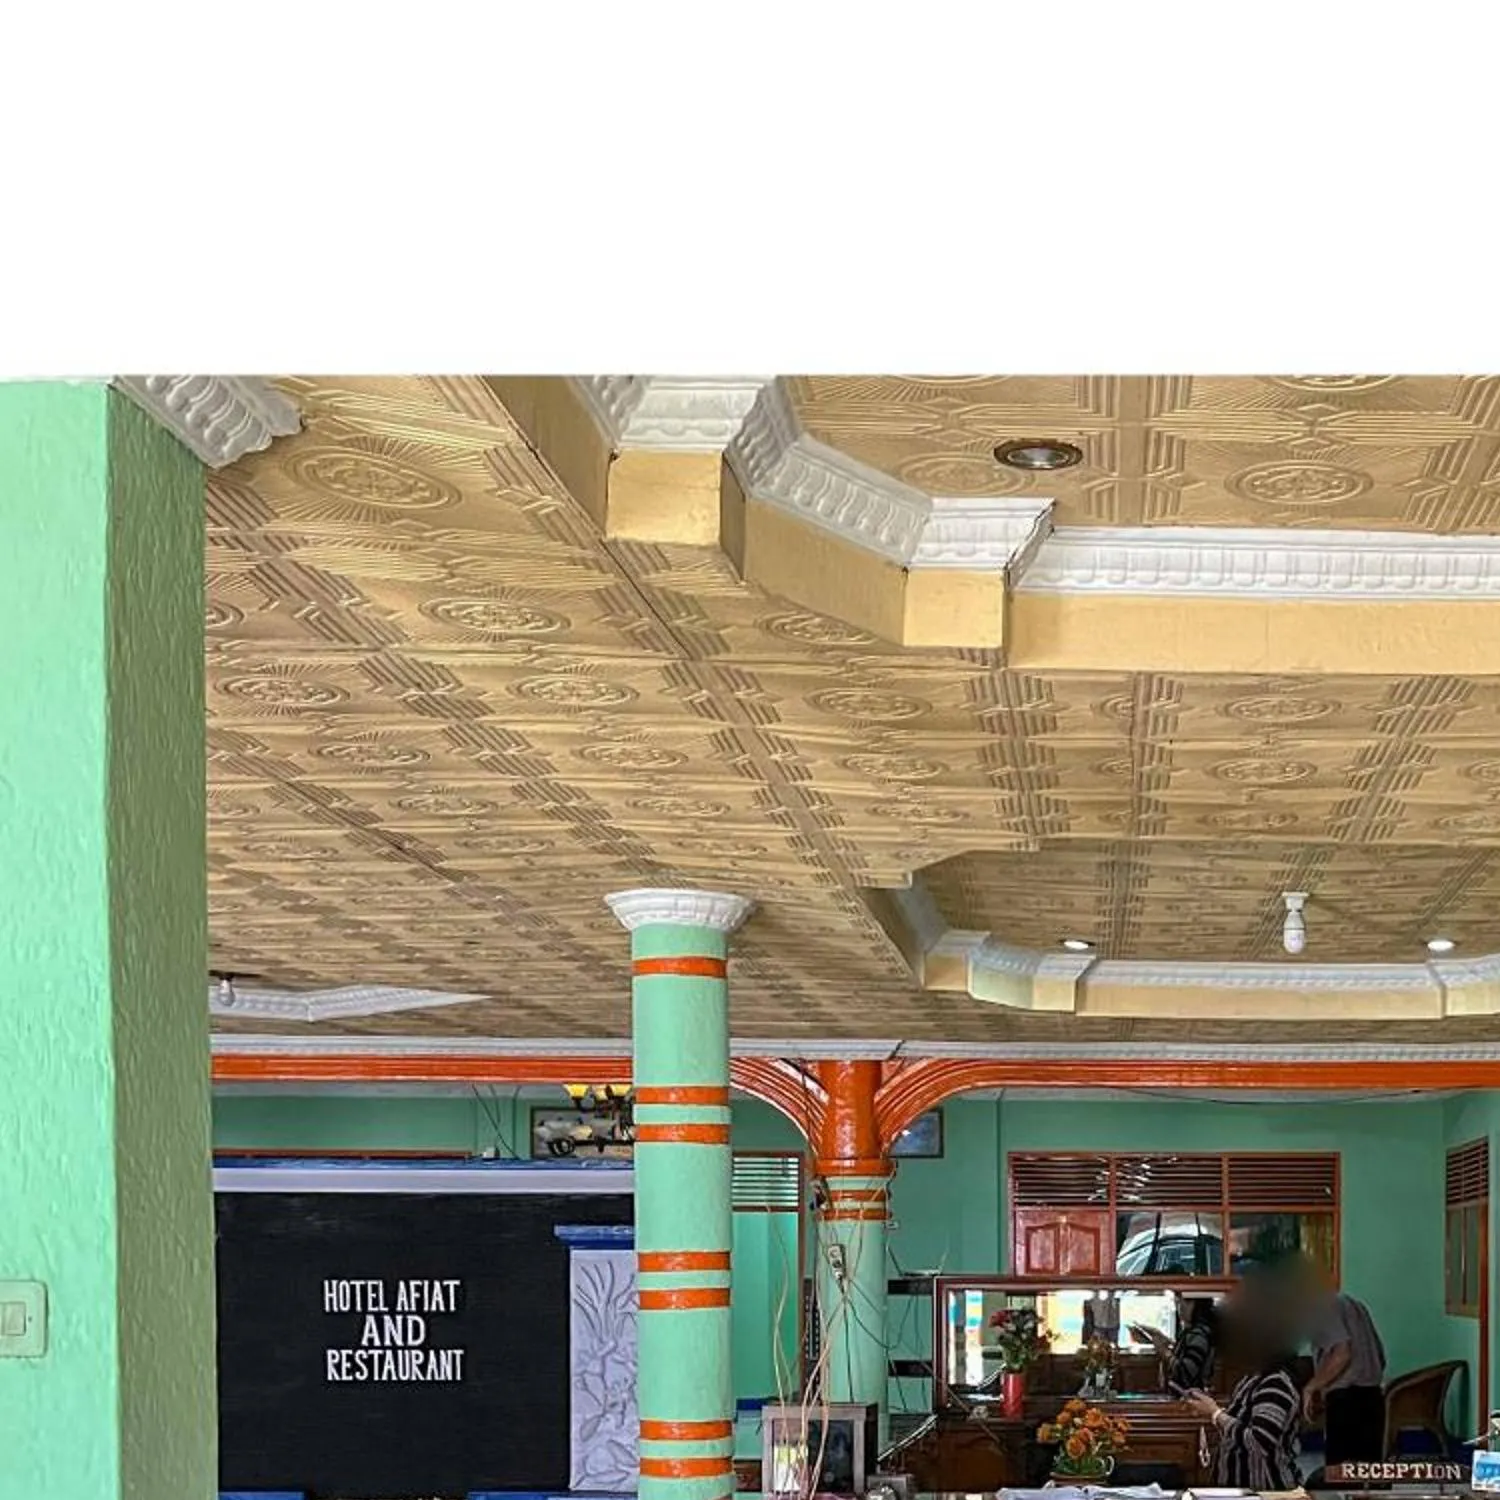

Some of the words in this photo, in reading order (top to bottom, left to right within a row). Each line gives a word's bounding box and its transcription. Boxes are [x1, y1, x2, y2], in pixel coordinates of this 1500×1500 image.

[323, 1279, 389, 1313] HOTEL
[396, 1279, 461, 1312] AFIAT
[361, 1314, 426, 1347] AND
[326, 1349, 465, 1381] RESTAURANT
[1341, 1462, 1462, 1480] RECEPTION
